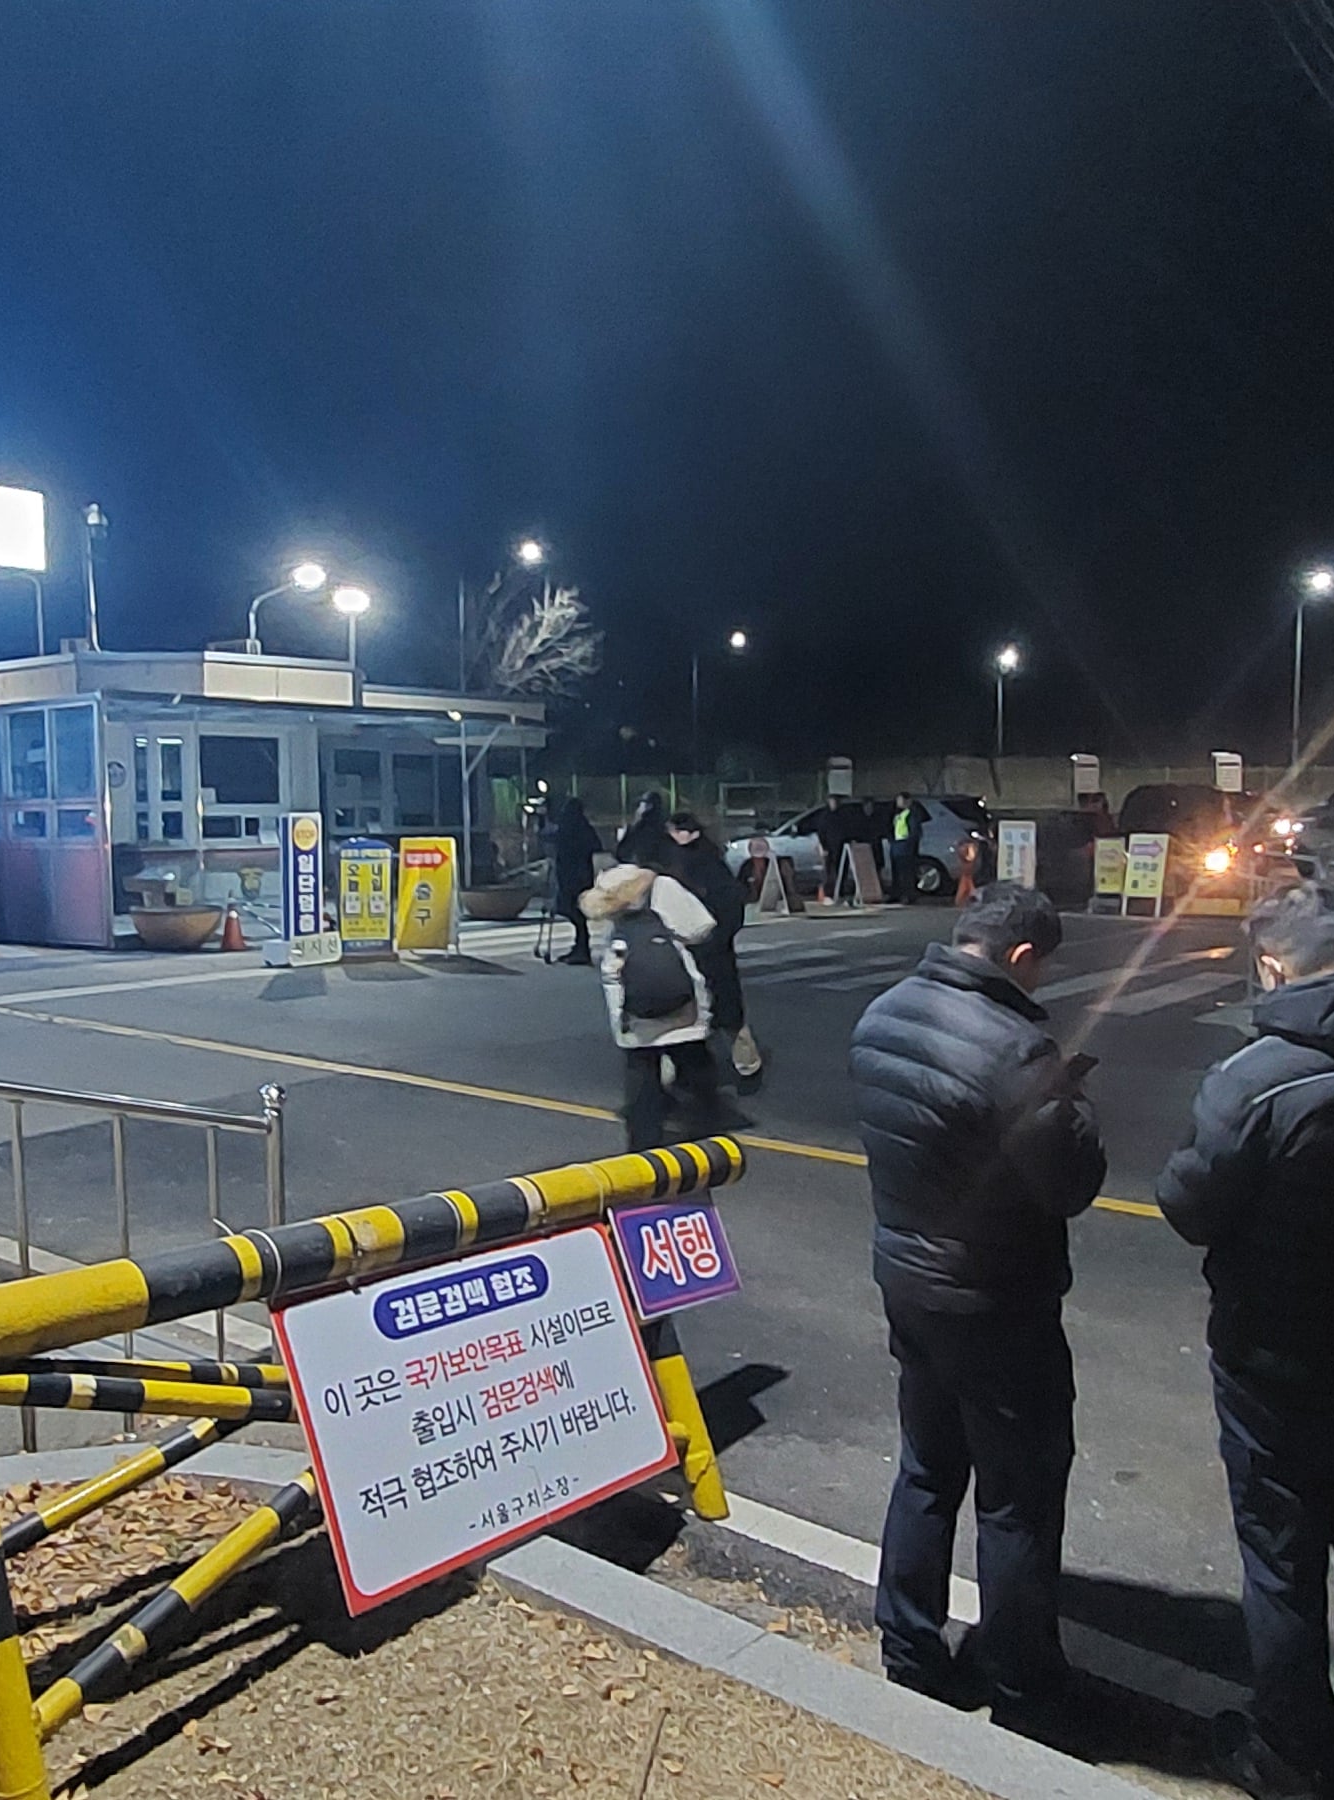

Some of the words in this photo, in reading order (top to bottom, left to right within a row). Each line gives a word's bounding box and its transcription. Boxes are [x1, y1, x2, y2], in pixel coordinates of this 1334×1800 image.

[640, 1210, 722, 1287] 서행
[389, 1276, 489, 1331] 검문검색
[490, 1265, 539, 1302] 협조
[323, 1382, 351, 1417] 이
[354, 1368, 402, 1413] 곳은
[405, 1330, 527, 1390] 국가보안목표
[529, 1301, 616, 1350] 시설이므로
[411, 1398, 478, 1446] 출입시
[479, 1360, 575, 1421] 검문검색에
[359, 1476, 407, 1519] 적극
[411, 1444, 498, 1500] 협조하여
[500, 1415, 560, 1465] 주시기
[561, 1387, 637, 1437] 바랍니다.
